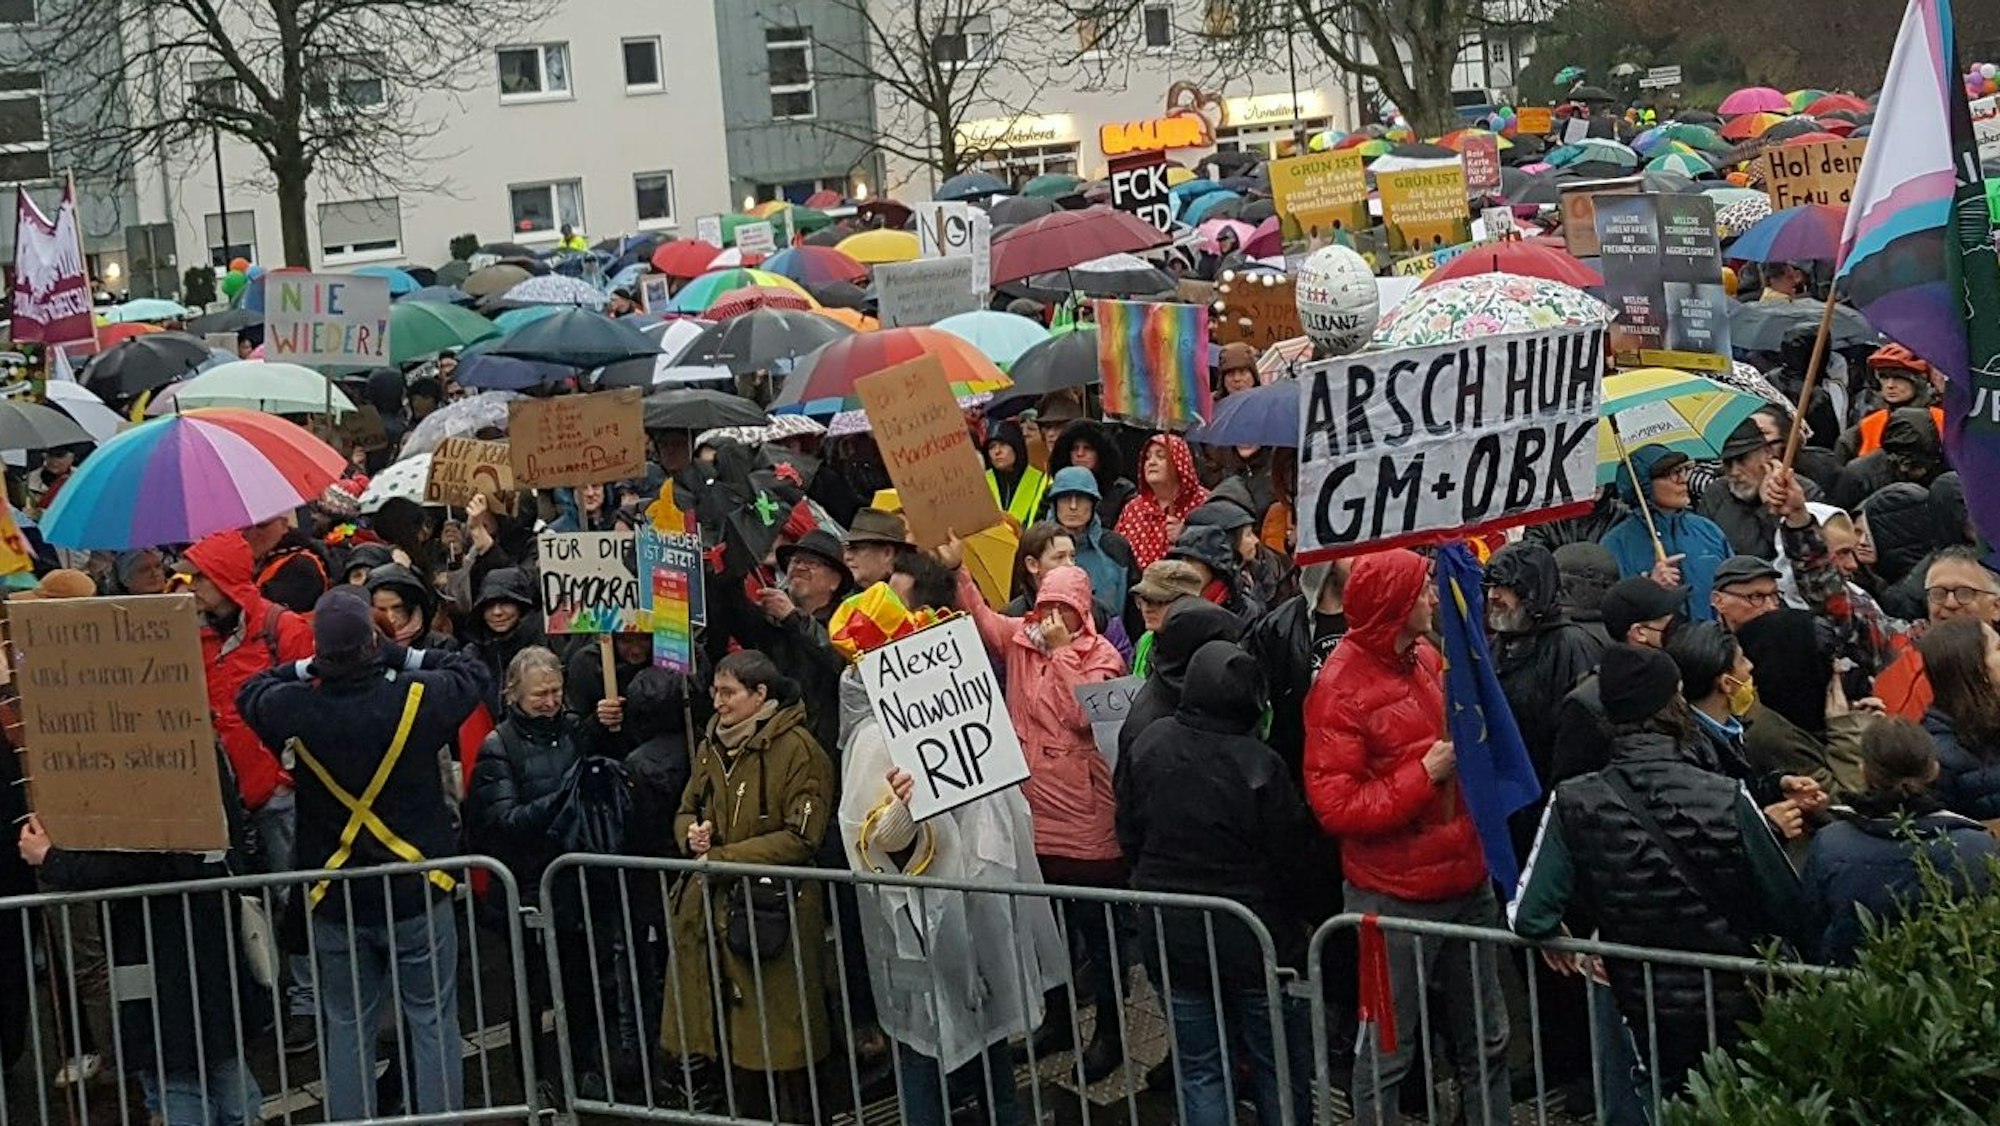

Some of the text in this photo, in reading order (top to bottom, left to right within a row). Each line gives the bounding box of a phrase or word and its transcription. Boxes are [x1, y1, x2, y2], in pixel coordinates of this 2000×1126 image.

[1291, 155, 1360, 177] GRÜN IST
[1821, 143, 1863, 174] dein
[1112, 163, 1170, 205] FCK
[1286, 180, 1364, 202] einer bunten
[1304, 168, 1361, 187] die Farbe
[1394, 172, 1461, 189] GRÜN IST
[1407, 187, 1425, 198] die
[1428, 185, 1462, 197] Farbe
[1125, 203, 1173, 233] FD
[1391, 197, 1464, 214] einer bunten
[281, 282, 345, 315] NIE
[271, 320, 387, 356] WIEDER!
[1301, 328, 1602, 463] ARSCH HUH
[541, 538, 634, 560] FÜR DIE
[661, 547, 696, 569] JETZT!
[543, 571, 640, 615] DEMOKRA
[31, 658, 67, 688] und
[79, 666, 134, 686] euren
[879, 631, 963, 688] Alexej
[109, 701, 142, 733] Ihr
[878, 670, 993, 739] Nawalny
[42, 742, 116, 773] anders
[916, 722, 993, 799] RIP
